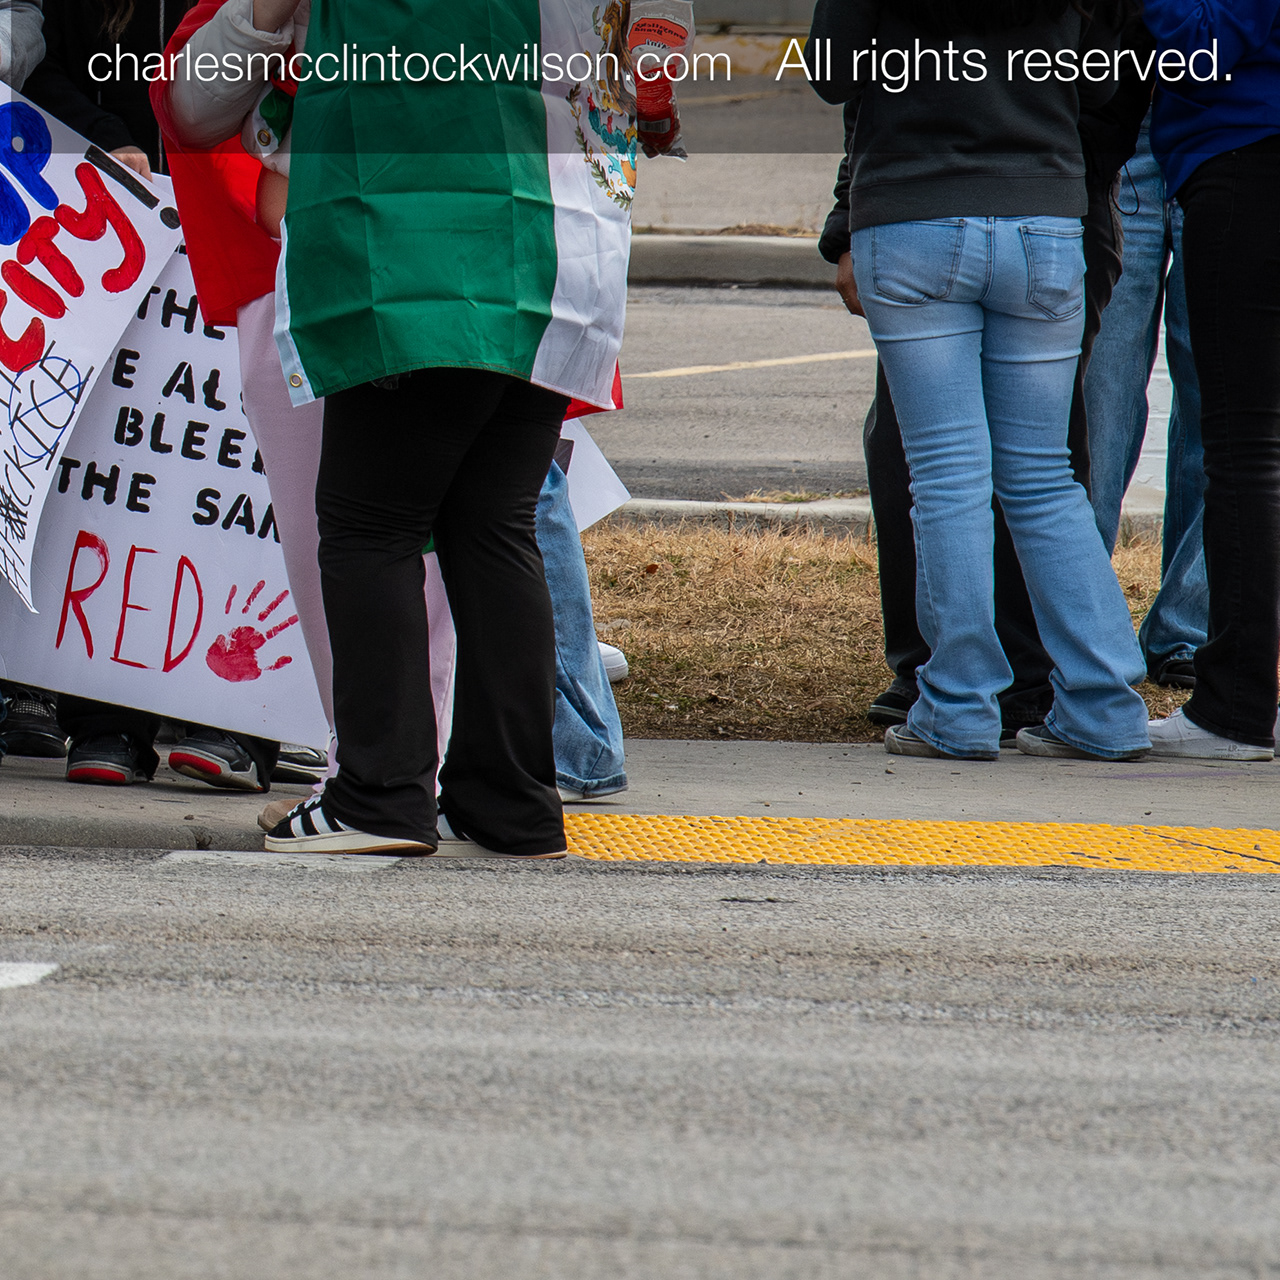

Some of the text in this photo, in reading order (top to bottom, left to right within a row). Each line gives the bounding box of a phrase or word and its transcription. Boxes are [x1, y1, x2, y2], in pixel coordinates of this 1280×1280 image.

[162, 361, 248, 418] AL
[57, 456, 157, 514] THE
[55, 530, 205, 673] RED
